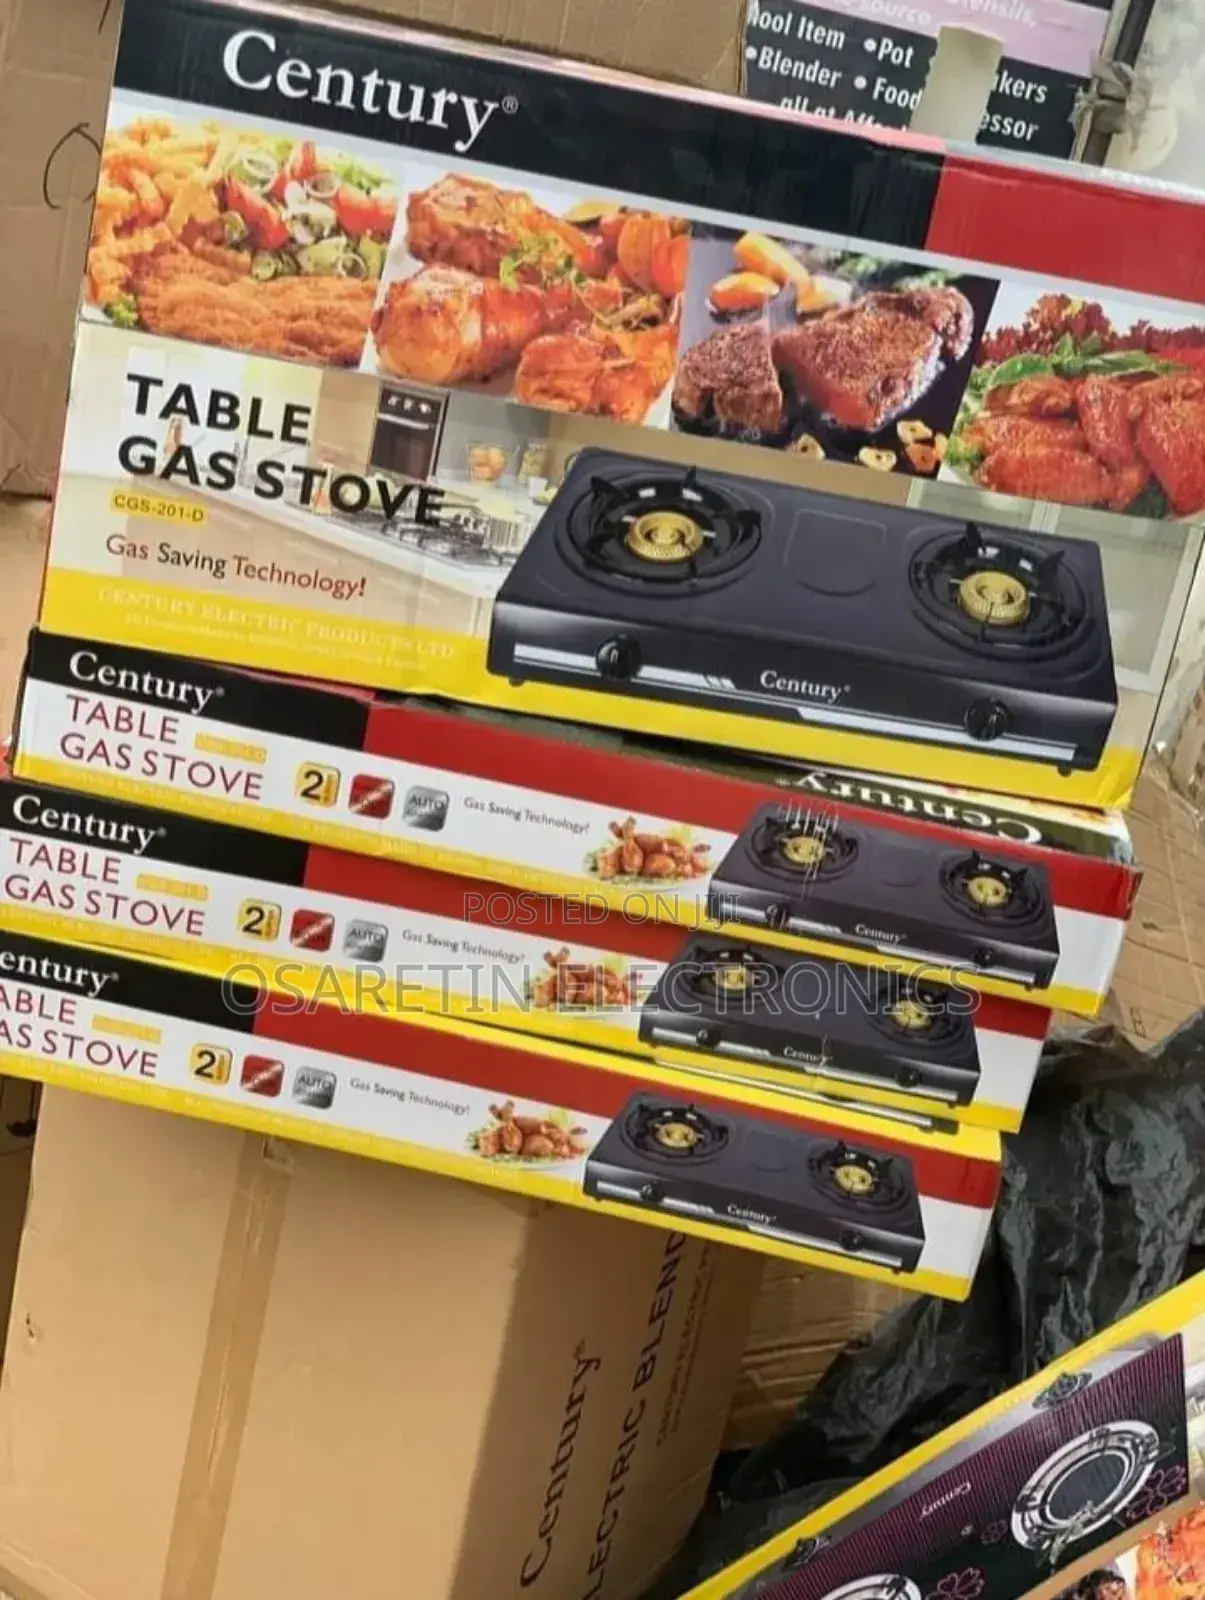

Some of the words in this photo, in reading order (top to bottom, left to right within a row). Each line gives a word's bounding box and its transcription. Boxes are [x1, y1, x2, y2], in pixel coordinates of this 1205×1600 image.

[758, 46, 842, 89] Blender
[872, 77, 923, 111] Food
[797, 16, 845, 50] Item
[878, 37, 915, 68] Pot
[994, 70, 1048, 104] kers
[126, 373, 312, 446] TABLE
[119, 436, 238, 491] GAS
[254, 460, 445, 527] STOVE
[114, 494, 204, 522] CGS-201-D
[106, 535, 148, 560] Gas
[157, 542, 226, 579] Saving
[233, 556, 366, 599] Technology!
[100, 586, 196, 615] CENTURY
[66, 694, 179, 744] TABLE
[60, 732, 132, 770] GAS
[141, 750, 264, 800] STOVE
[300, 770, 323, 800] 2
[464, 797, 486, 811] Gas
[489, 802, 521, 821] Saving
[525, 809, 590, 834] Technology!
[9, 837, 121, 884] TABLE
[5, 874, 75, 910] GAS
[85, 890, 205, 936] STOVE
[242, 906, 265, 935] 2
[402, 929, 423, 943] Gas
[426, 934, 459, 953] Saving
[42, 1029, 159, 1078] STOVE
[194, 1051, 216, 1079] 2
[350, 1078, 371, 1091] Gas
[374, 1082, 406, 1102] Saving
[409, 1091, 471, 1115] Technology!
[579, 1399, 647, 1600] LECTRIC
